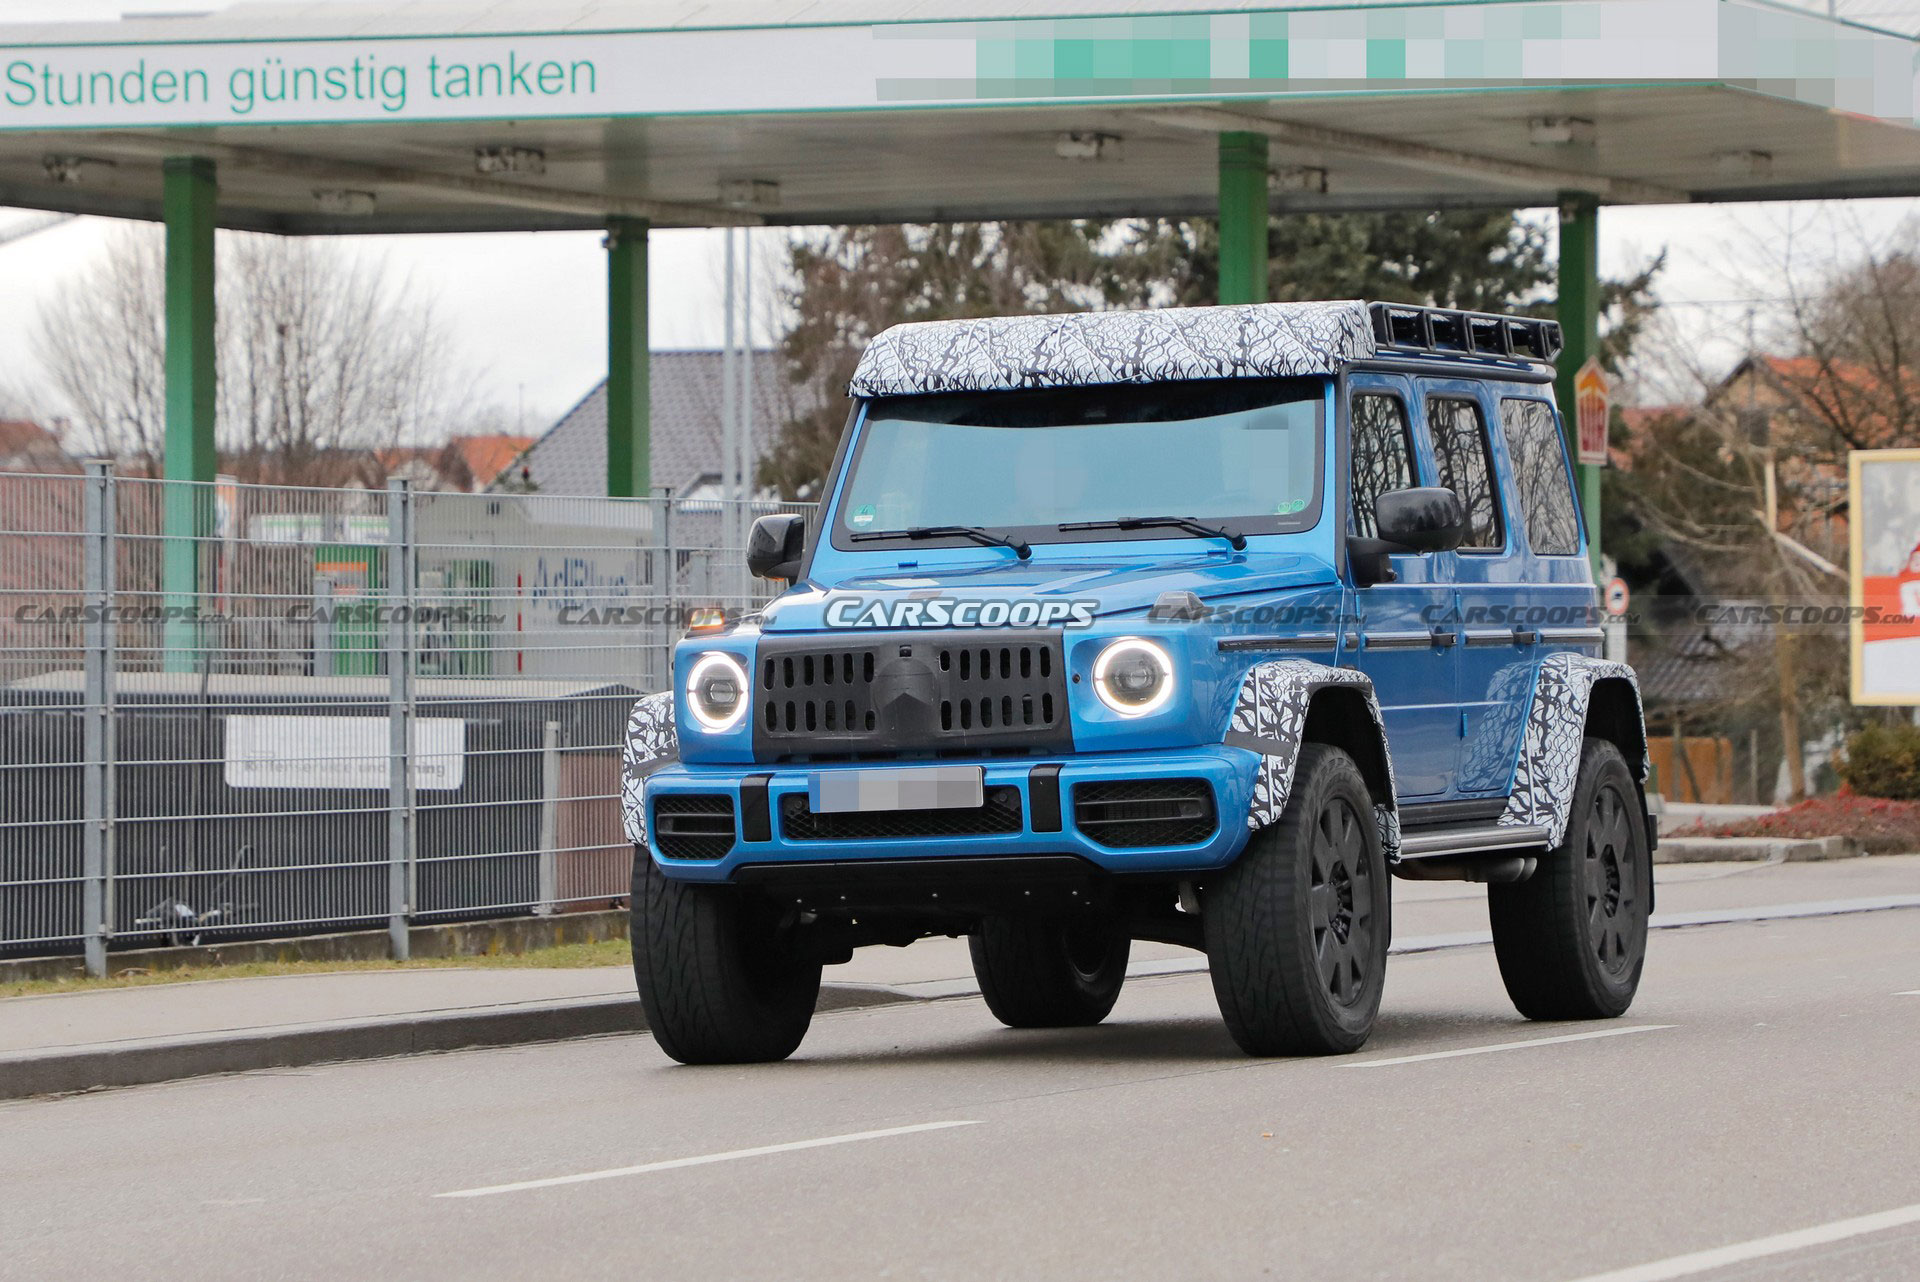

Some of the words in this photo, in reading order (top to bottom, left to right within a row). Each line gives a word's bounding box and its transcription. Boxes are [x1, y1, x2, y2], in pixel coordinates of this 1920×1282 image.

[5, 59, 208, 106] Stunden
[229, 55, 406, 113] günstig
[427, 51, 596, 98] tanken
